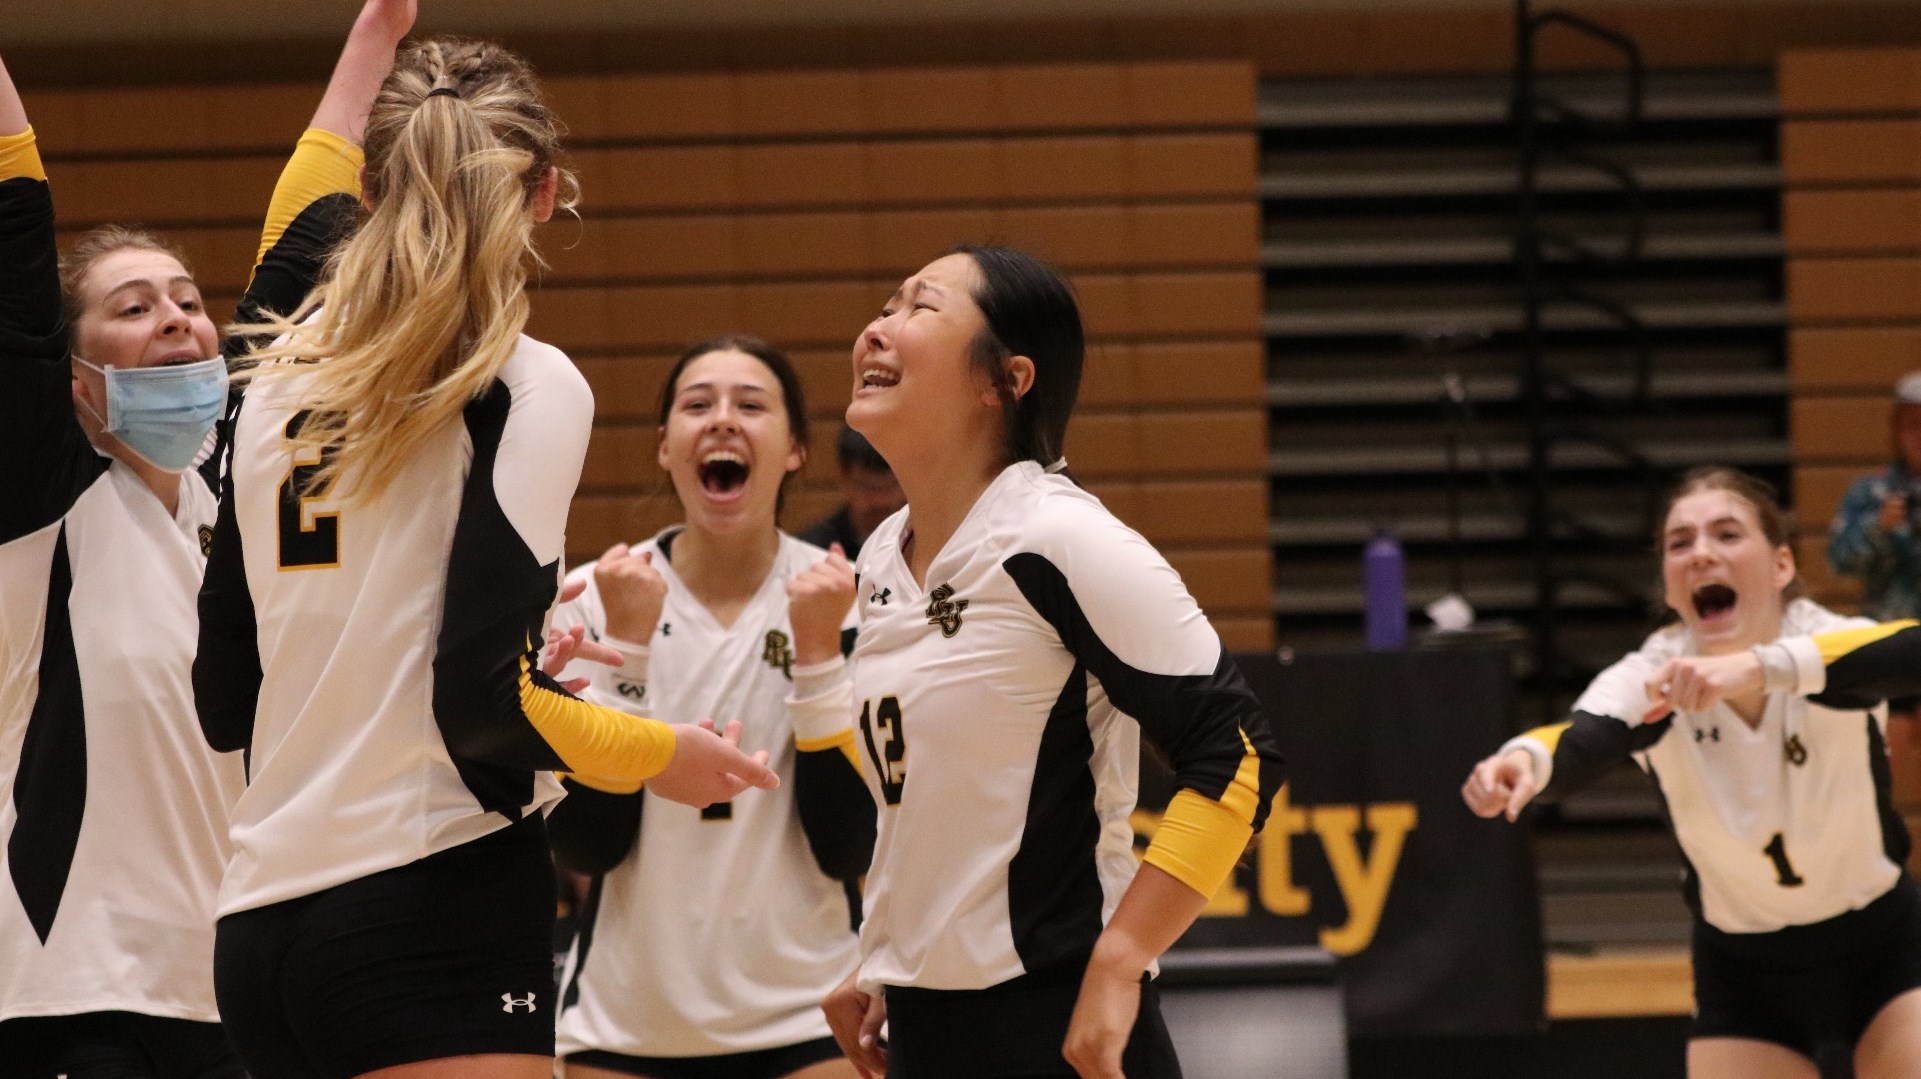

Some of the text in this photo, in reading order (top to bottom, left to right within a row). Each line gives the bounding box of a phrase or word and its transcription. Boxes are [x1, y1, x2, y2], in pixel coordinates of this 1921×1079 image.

[277, 403, 348, 572] 2
[859, 693, 907, 808] 12
[1761, 830, 1806, 889] 1
